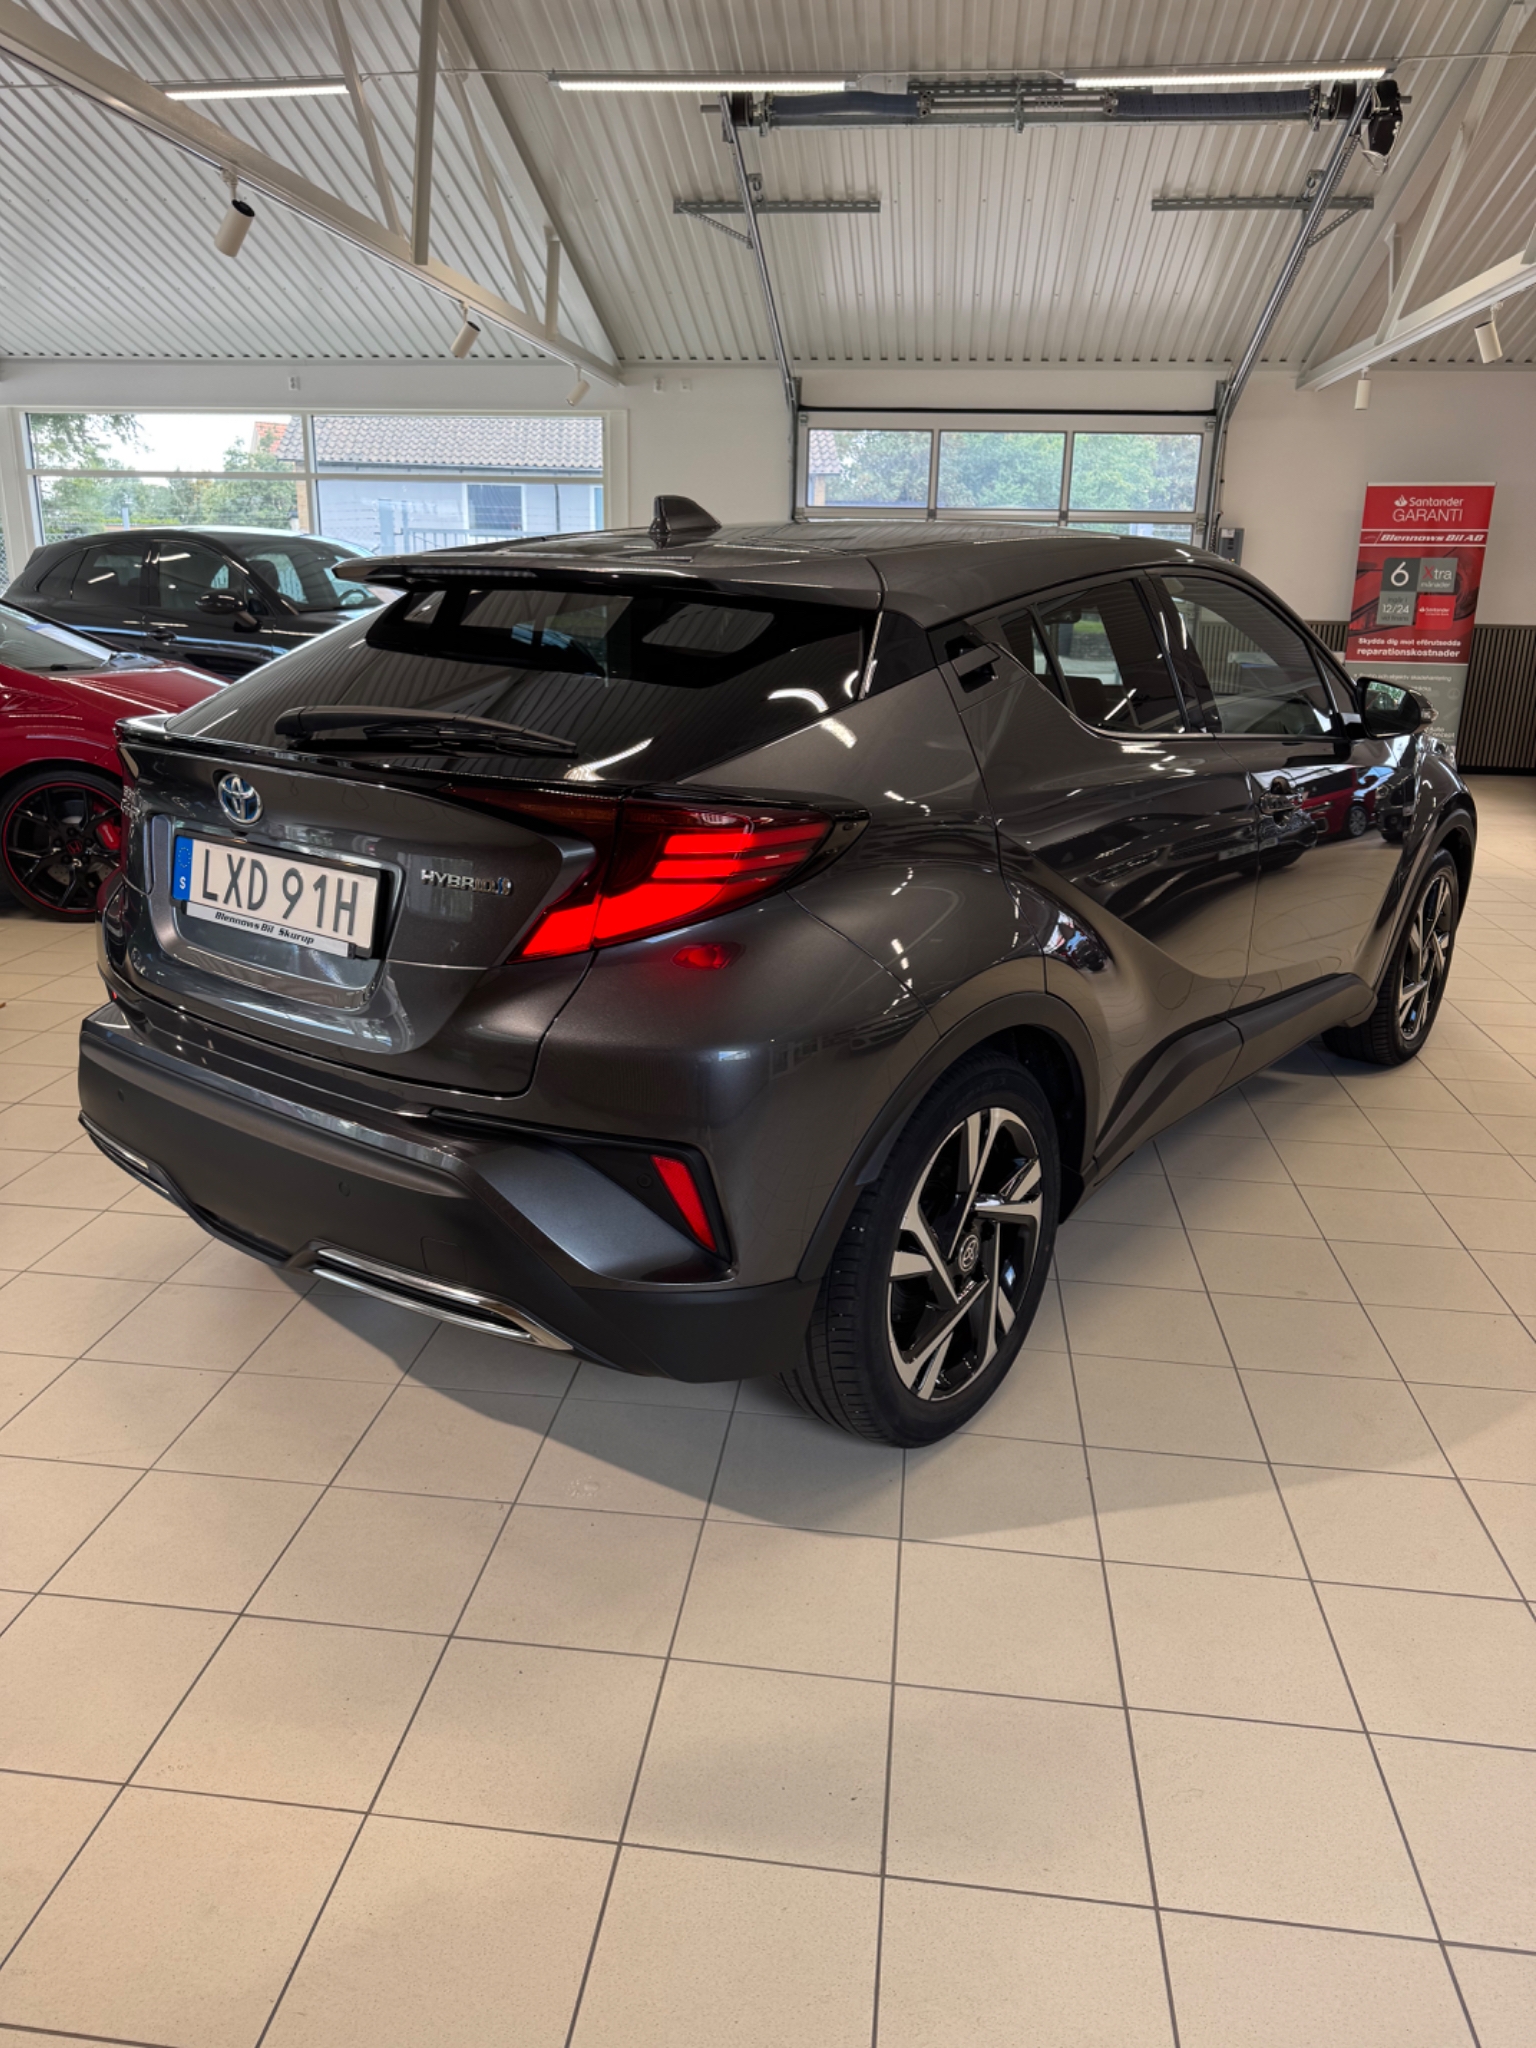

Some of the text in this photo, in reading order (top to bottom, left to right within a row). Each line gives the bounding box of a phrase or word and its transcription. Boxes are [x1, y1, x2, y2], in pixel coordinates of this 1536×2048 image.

[1409, 497, 1464, 507] Santander
[1392, 508, 1464, 522] GARANTI
[1380, 534, 1484, 542] Blennows Bil AB
[1390, 561, 1409, 587] 6
[1422, 565, 1452, 580] Xtra
[1382, 604, 1410, 614] 12/24
[1358, 638, 1385, 646] Skydda
[1386, 638, 1398, 646] dig
[1356, 647, 1460, 657] reparationskostnader
[179, 876, 186, 889] S
[421, 869, 496, 890] HYBRID
[202, 849, 359, 936] LXD 91H
[214, 911, 315, 945] Blennows Bil Skurup
